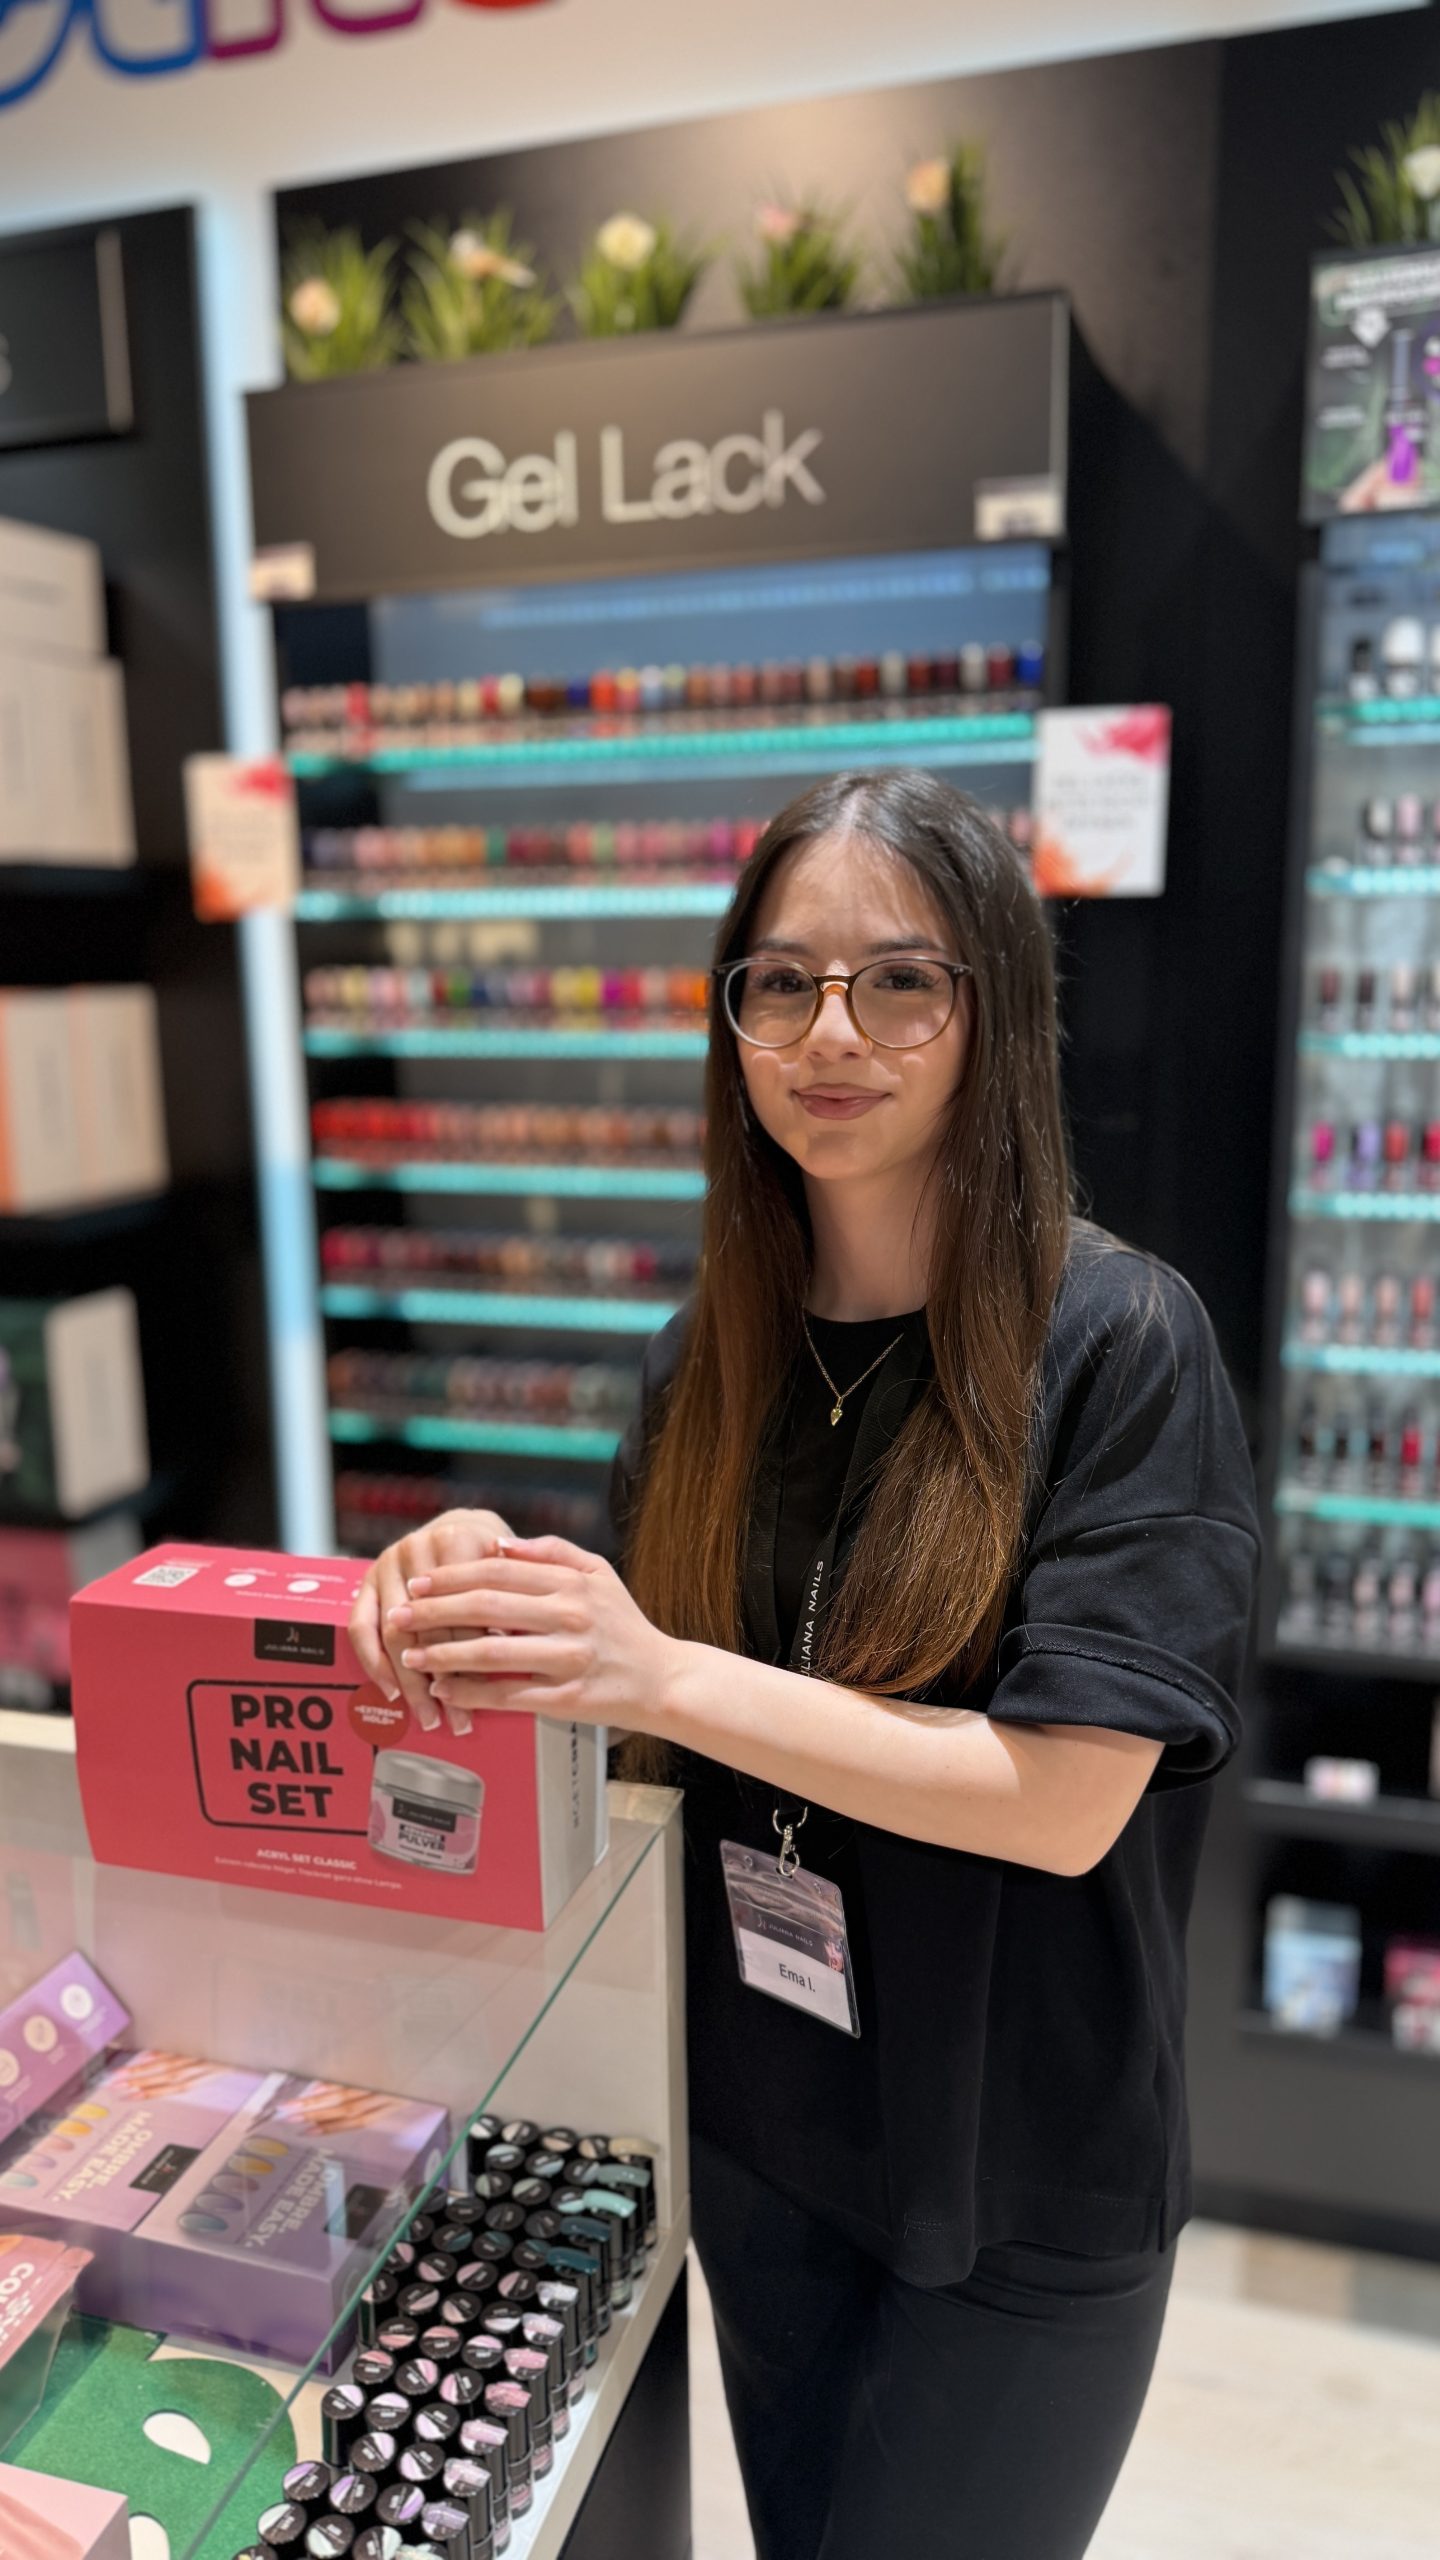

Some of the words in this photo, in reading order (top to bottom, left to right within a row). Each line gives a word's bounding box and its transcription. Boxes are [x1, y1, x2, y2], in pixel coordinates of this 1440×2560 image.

[427, 428, 579, 539] Gel
[600, 408, 827, 523] Lack
[800, 1620, 815, 1677] ULIANA
[808, 1561, 824, 1611] NAILS
[230, 1694, 333, 1731] PRO
[229, 1738, 344, 1776] NAIL
[247, 1782, 333, 1818] SET
[256, 1848, 290, 1861] ACRYL
[292, 1852, 311, 1864] SET
[313, 1856, 357, 1870] CLASSIC
[398, 1832, 445, 1852] PULVER
[779, 1963, 805, 1987] Ema
[99, 2111, 153, 2157] MADE
